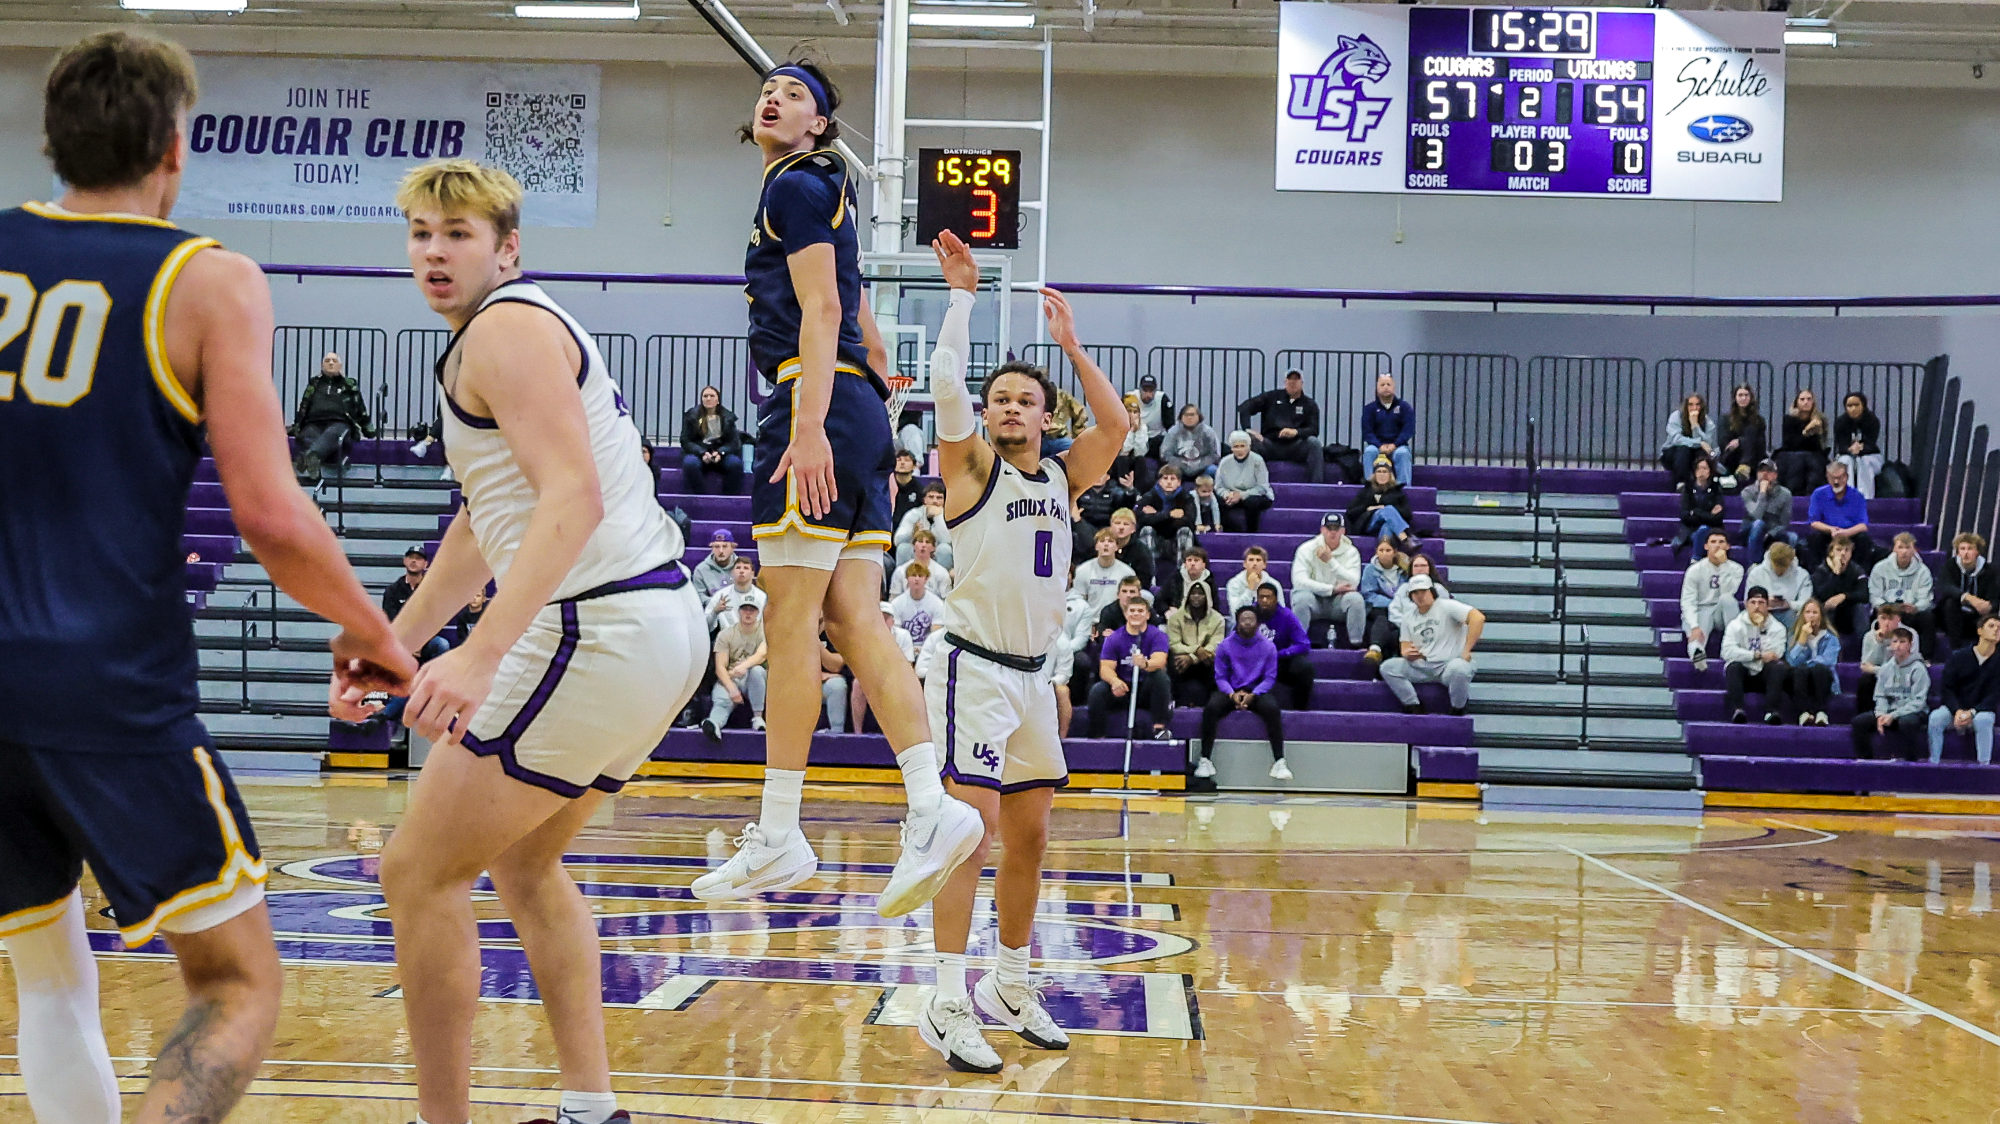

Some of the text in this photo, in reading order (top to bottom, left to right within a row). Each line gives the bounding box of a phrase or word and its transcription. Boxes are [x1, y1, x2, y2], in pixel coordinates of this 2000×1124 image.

[1491, 11, 1589, 52] 15:29
[1424, 56, 1495, 77] COUGARS
[1508, 68, 1553, 82] PERIOD
[1567, 59, 1637, 80] VIKINGS
[286, 87, 371, 109] JOIN THE
[1427, 80, 1476, 119] 57
[1665, 57, 1772, 116] Schulte
[1287, 74, 1393, 142] USF
[1520, 86, 1540, 118] 2
[1595, 84, 1645, 123] 54
[191, 113, 466, 158] COUGAR CLUB
[1411, 123, 1450, 137] FOULS
[1491, 124, 1572, 140] PLAYER FOUL
[1609, 127, 1649, 142] FOULS
[1295, 149, 1383, 166] COUGARS
[1426, 139, 1443, 169] 3
[1514, 141, 1565, 172] 0 3
[1624, 142, 1643, 174] 0
[1677, 151, 1762, 164] SUBARU
[293, 163, 359, 184] TODAY!
[937, 157, 1011, 187] 15:29
[1408, 174, 1448, 188] SCORE
[1507, 176, 1550, 190] MATCH
[1607, 178, 1648, 193] SCORE
[228, 202, 404, 217] USFCOUGARS.COM/COUGARC
[971, 189, 997, 238] 3
[0, 270, 113, 408] 20
[1006, 498, 1047, 522] SIOUX
[1034, 530, 1053, 577] 0
[973, 742, 999, 772] USF
